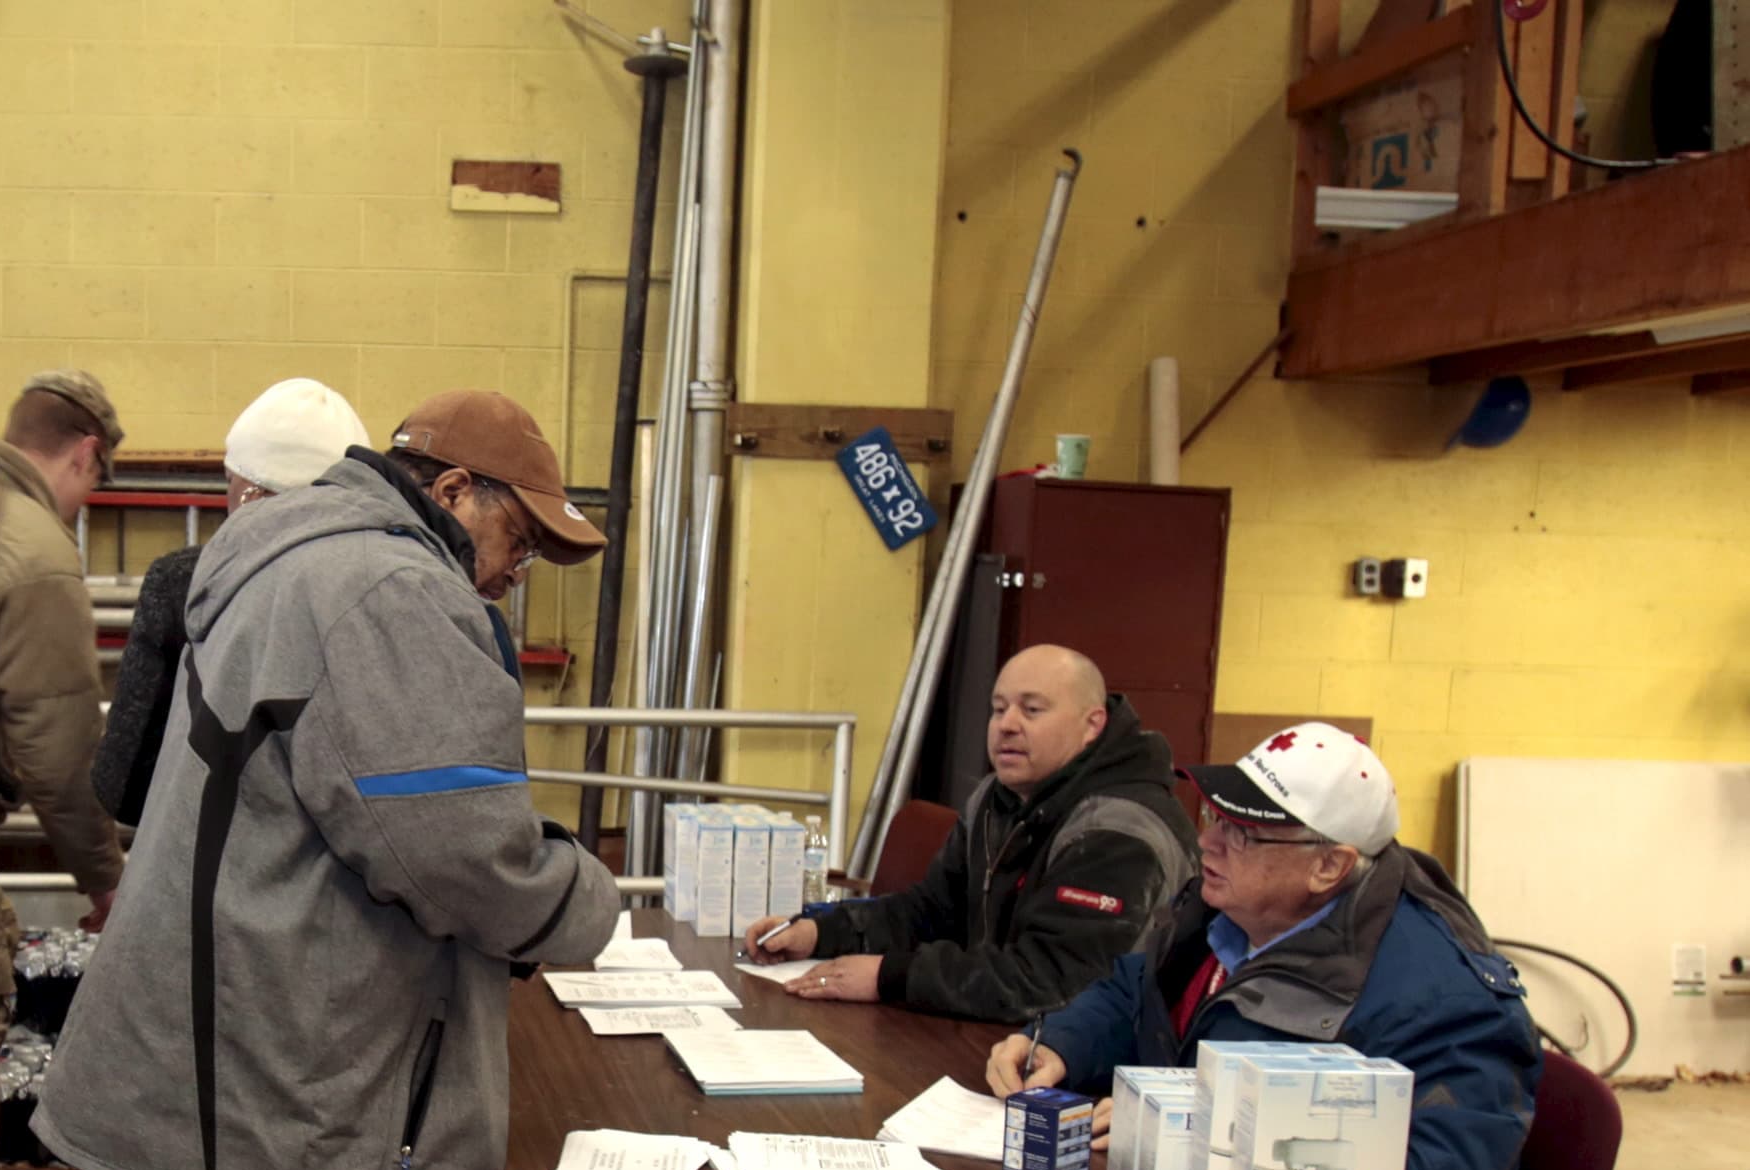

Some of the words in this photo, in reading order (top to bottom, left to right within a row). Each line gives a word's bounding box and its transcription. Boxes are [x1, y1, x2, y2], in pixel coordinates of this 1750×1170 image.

[855, 443, 896, 490] 486
[887, 498, 924, 537] 92
[1266, 771, 1289, 798] Cross
